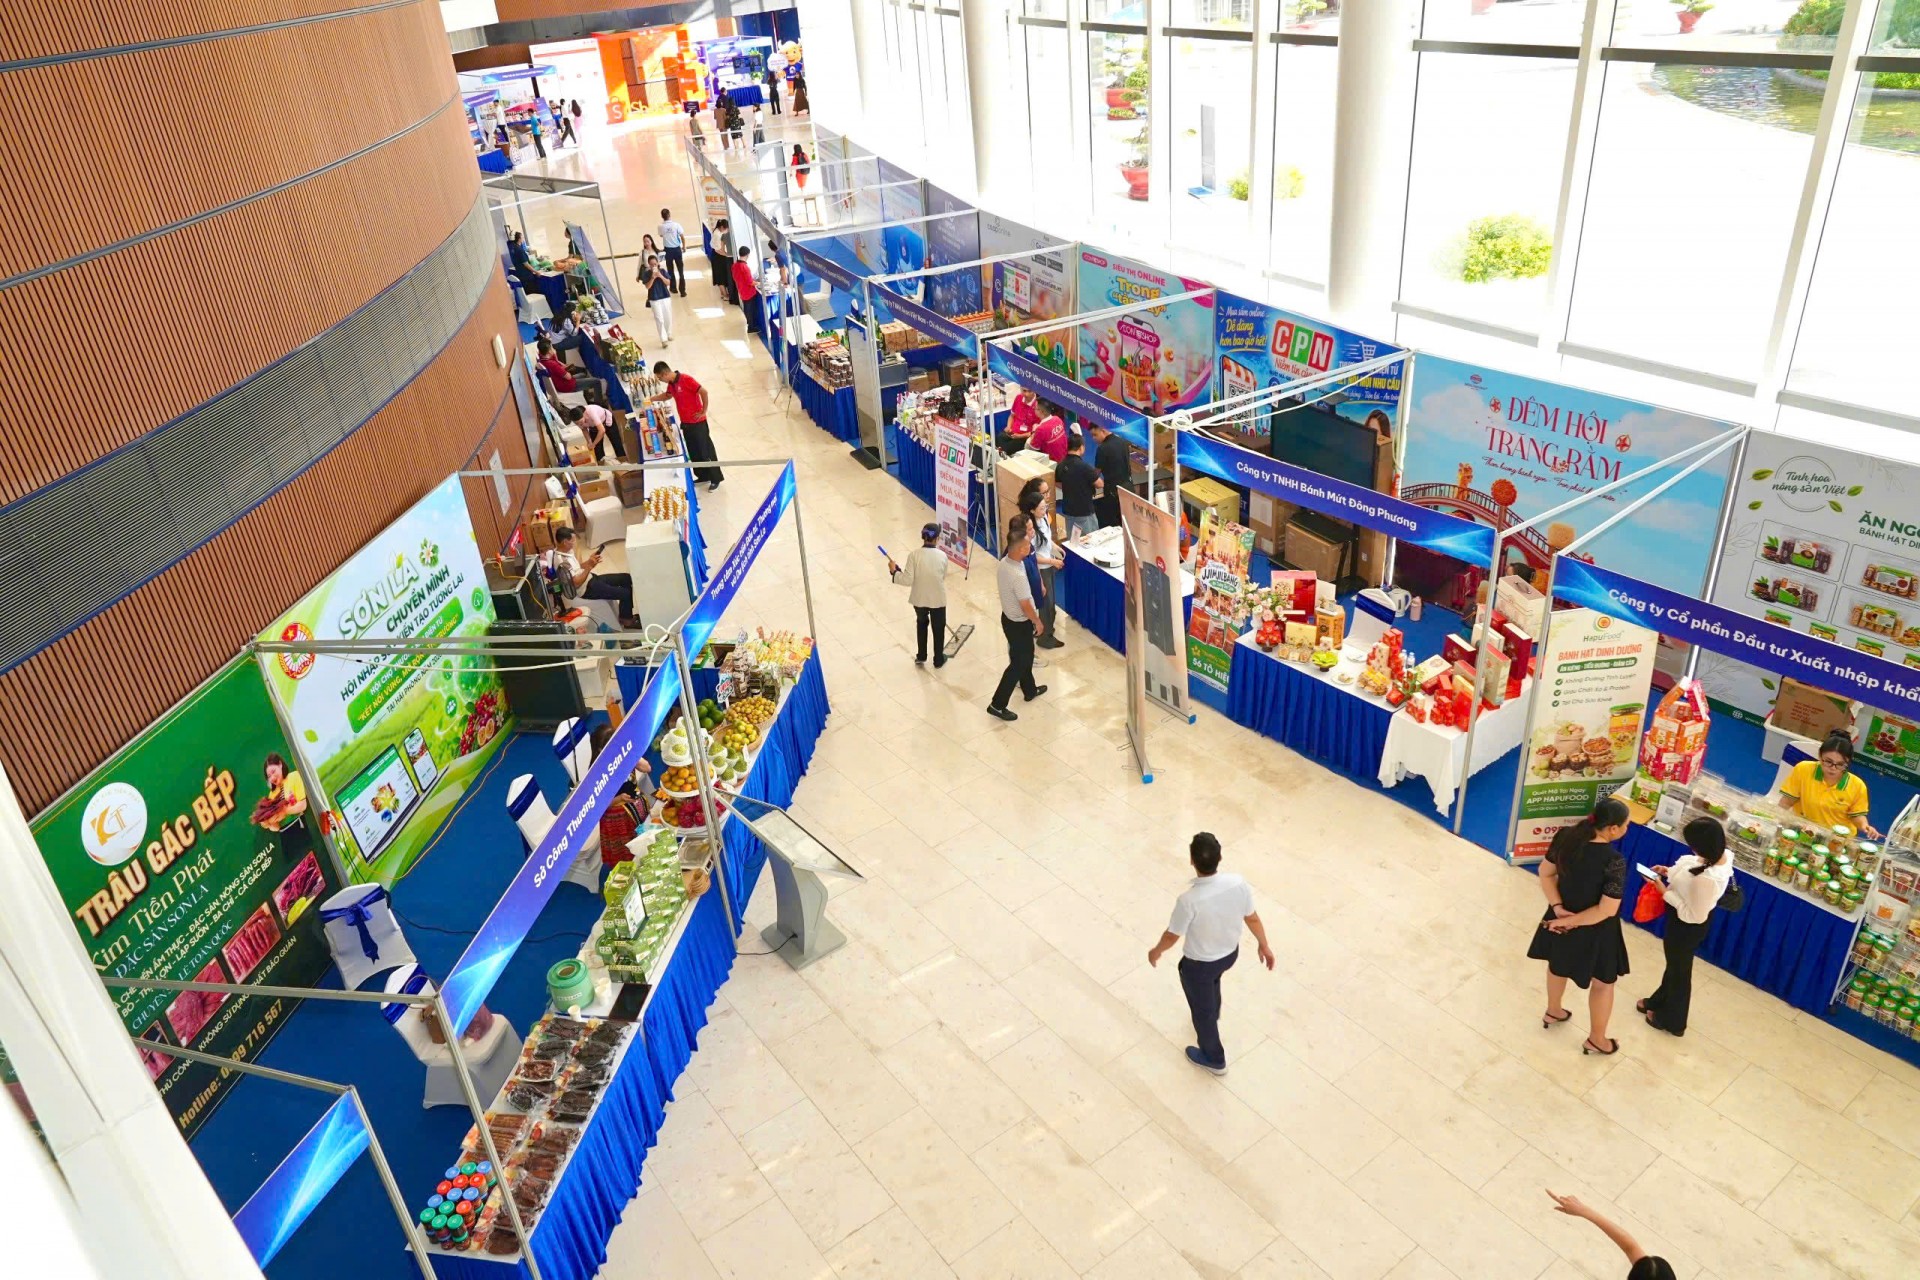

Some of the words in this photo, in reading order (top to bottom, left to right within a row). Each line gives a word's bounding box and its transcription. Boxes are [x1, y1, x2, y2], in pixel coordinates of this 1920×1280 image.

[1116, 276, 1161, 299] Trong
[1137, 270, 1165, 287] ONLINE
[1275, 325, 1331, 368] CPN
[1006, 361, 1019, 375] Công
[1025, 369, 1034, 379] CP
[1056, 384, 1077, 403] Thương
[1087, 401, 1100, 413] CPN
[1100, 406, 1111, 421] Việt
[1111, 413, 1126, 426] Nam
[939, 443, 966, 468] CPN
[1485, 426, 1560, 471] TRĂNG
[1566, 446, 1623, 483] RẰM
[1564, 409, 1608, 446] HỘI
[1236, 461, 1261, 478] Công
[1261, 470, 1272, 483] ty
[1272, 472, 1299, 491] TNHH
[1300, 482, 1326, 501] Bánh
[1327, 490, 1348, 508] Mứt
[1348, 497, 1377, 520] Đông
[1377, 508, 1417, 533] Phương
[1772, 483, 1798, 499] nông
[1799, 482, 1821, 494] sản
[1822, 484, 1846, 502] Việt
[1785, 470, 1809, 484] Tinh
[1809, 471, 1832, 484] hoa
[711, 578, 725, 600] Trung
[723, 566, 733, 583] tâm
[757, 503, 771, 527] Thương
[1858, 509, 1887, 535] ĂN
[1889, 519, 1920, 538] NG
[1858, 524, 1885, 547] BÁNH
[1887, 534, 1907, 546] HẠT
[731, 575, 738, 588] và
[735, 567, 743, 580] Du
[760, 527, 766, 538] La
[339, 588, 390, 641] SƠN
[387, 556, 420, 601] LA
[386, 588, 427, 633] CHUYỂN
[426, 564, 451, 595] MÌNH
[340, 681, 359, 702] HỘI
[356, 656, 382, 688] NHẬP
[414, 606, 431, 628] TẠO
[429, 583, 454, 615] TƯƠNG
[452, 572, 465, 593] LAI
[1193, 657, 1203, 668] 56
[1558, 649, 1579, 662] BÁNH
[1580, 647, 1595, 659] HẠT
[1616, 642, 1643, 656] DƯỠNG
[1609, 586, 1647, 615] Công
[1648, 605, 1666, 625] ty
[1667, 604, 1690, 628] Cổ
[1690, 615, 1732, 645] phần
[1732, 627, 1769, 655] Đầu
[1769, 645, 1791, 667] tư
[1789, 650, 1833, 682] Xuất
[1833, 668, 1880, 700] nhập
[371, 693, 386, 711] NỐI
[386, 699, 397, 714] TẠI
[395, 688, 407, 707] HẢI
[404, 673, 423, 697] PHÒNG
[533, 865, 547, 888] Sở
[546, 835, 569, 870] Công
[566, 794, 597, 838] Thương
[593, 772, 610, 798] tỉnh
[607, 754, 624, 777] Sơn
[621, 739, 634, 761] La
[1543, 794, 1590, 804] HAPUFOOD
[75, 857, 148, 938] TRÂU
[145, 814, 196, 875] GÁC
[192, 765, 236, 834] BẾP
[128, 889, 175, 935] Tiền
[171, 848, 217, 897] Phát
[164, 934, 185, 960] THỰC
[188, 917, 205, 938] ĐẶC
[219, 876, 241, 905] NÔNG
[237, 861, 255, 882] SẢN
[252, 850, 268, 869] SƠN
[265, 842, 276, 856] LA
[114, 944, 143, 980] ĐẶC
[142, 920, 169, 957] SẢN
[168, 897, 193, 930] SƠN
[189, 883, 210, 914] LA
[121, 1003, 135, 1018] BÒ
[174, 946, 190, 969] LẠP
[188, 923, 210, 951] SƯỜN
[211, 909, 223, 925] BA
[221, 891, 235, 917] CHỈ
[236, 884, 249, 901] CÁ
[247, 869, 262, 890] GÁC
[259, 855, 274, 875] BẾP
[188, 940, 213, 971] TOÀN
[209, 918, 234, 951] QUỐC
[171, 1056, 196, 1083] CÔNG
[198, 1020, 224, 1053] KHÔNG
[221, 1007, 234, 1025] SỬ
[231, 993, 253, 1016] DỤNG
[265, 954, 282, 973] BẢO
[278, 935, 298, 962] QUẢN
[178, 1073, 223, 1130] Hotline:
[244, 1021, 266, 1050] 716
[263, 998, 284, 1027] 567
